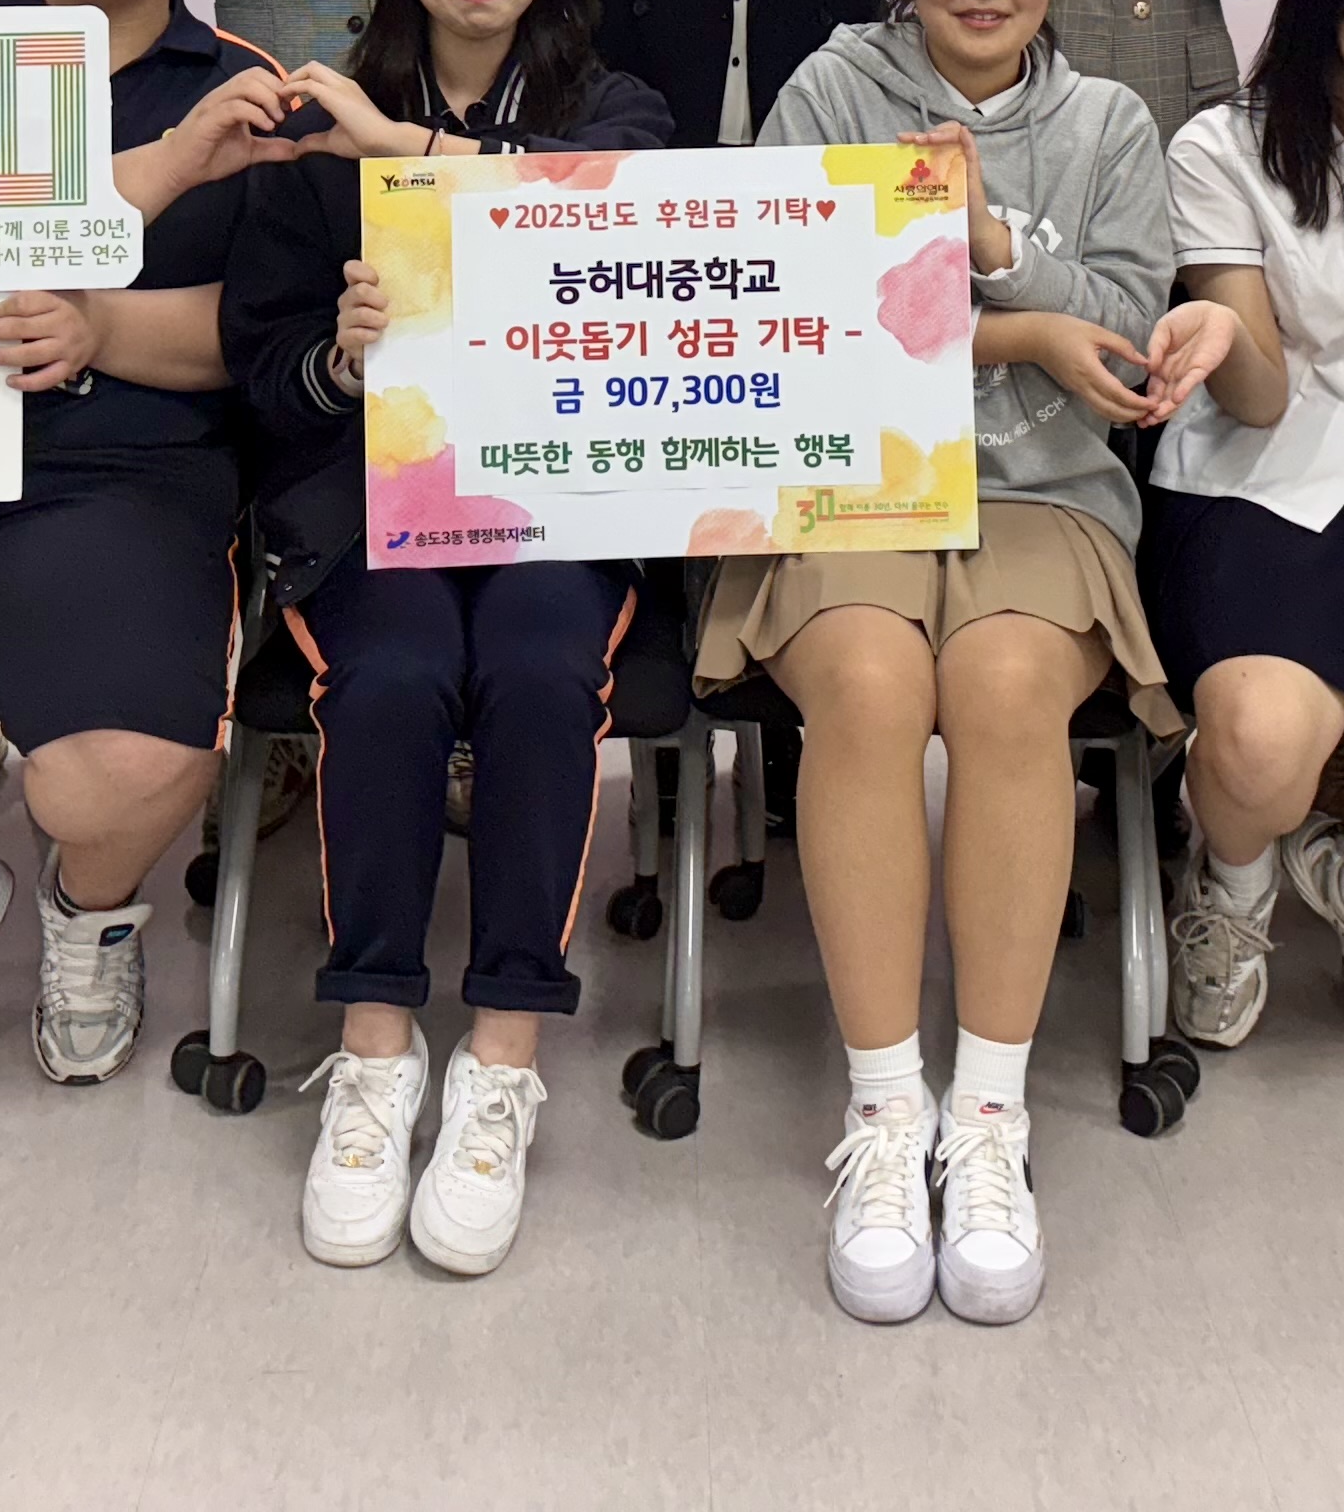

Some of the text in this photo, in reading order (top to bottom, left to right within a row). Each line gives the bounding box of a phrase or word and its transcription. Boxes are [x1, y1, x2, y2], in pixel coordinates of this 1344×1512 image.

[381, 174, 435, 191] Yeonsu
[34, 220, 70, 240] 이룬
[79, 218, 131, 240] 30년,
[515, 197, 811, 230] 2025년도 후원금 기탁
[29, 245, 84, 267] 꿈꾸는
[92, 244, 129, 266] 연수
[549, 257, 780, 304] 능허대중학교
[506, 320, 647, 361] 이웃돕기
[668, 317, 738, 358] 성금
[758, 316, 829, 355] 기탁
[552, 372, 781, 414] 금 907,300원
[481, 433, 854, 476] 따뜻한 동행 함께하는 행복
[414, 526, 545, 547] 송도3동 행정복지센터
